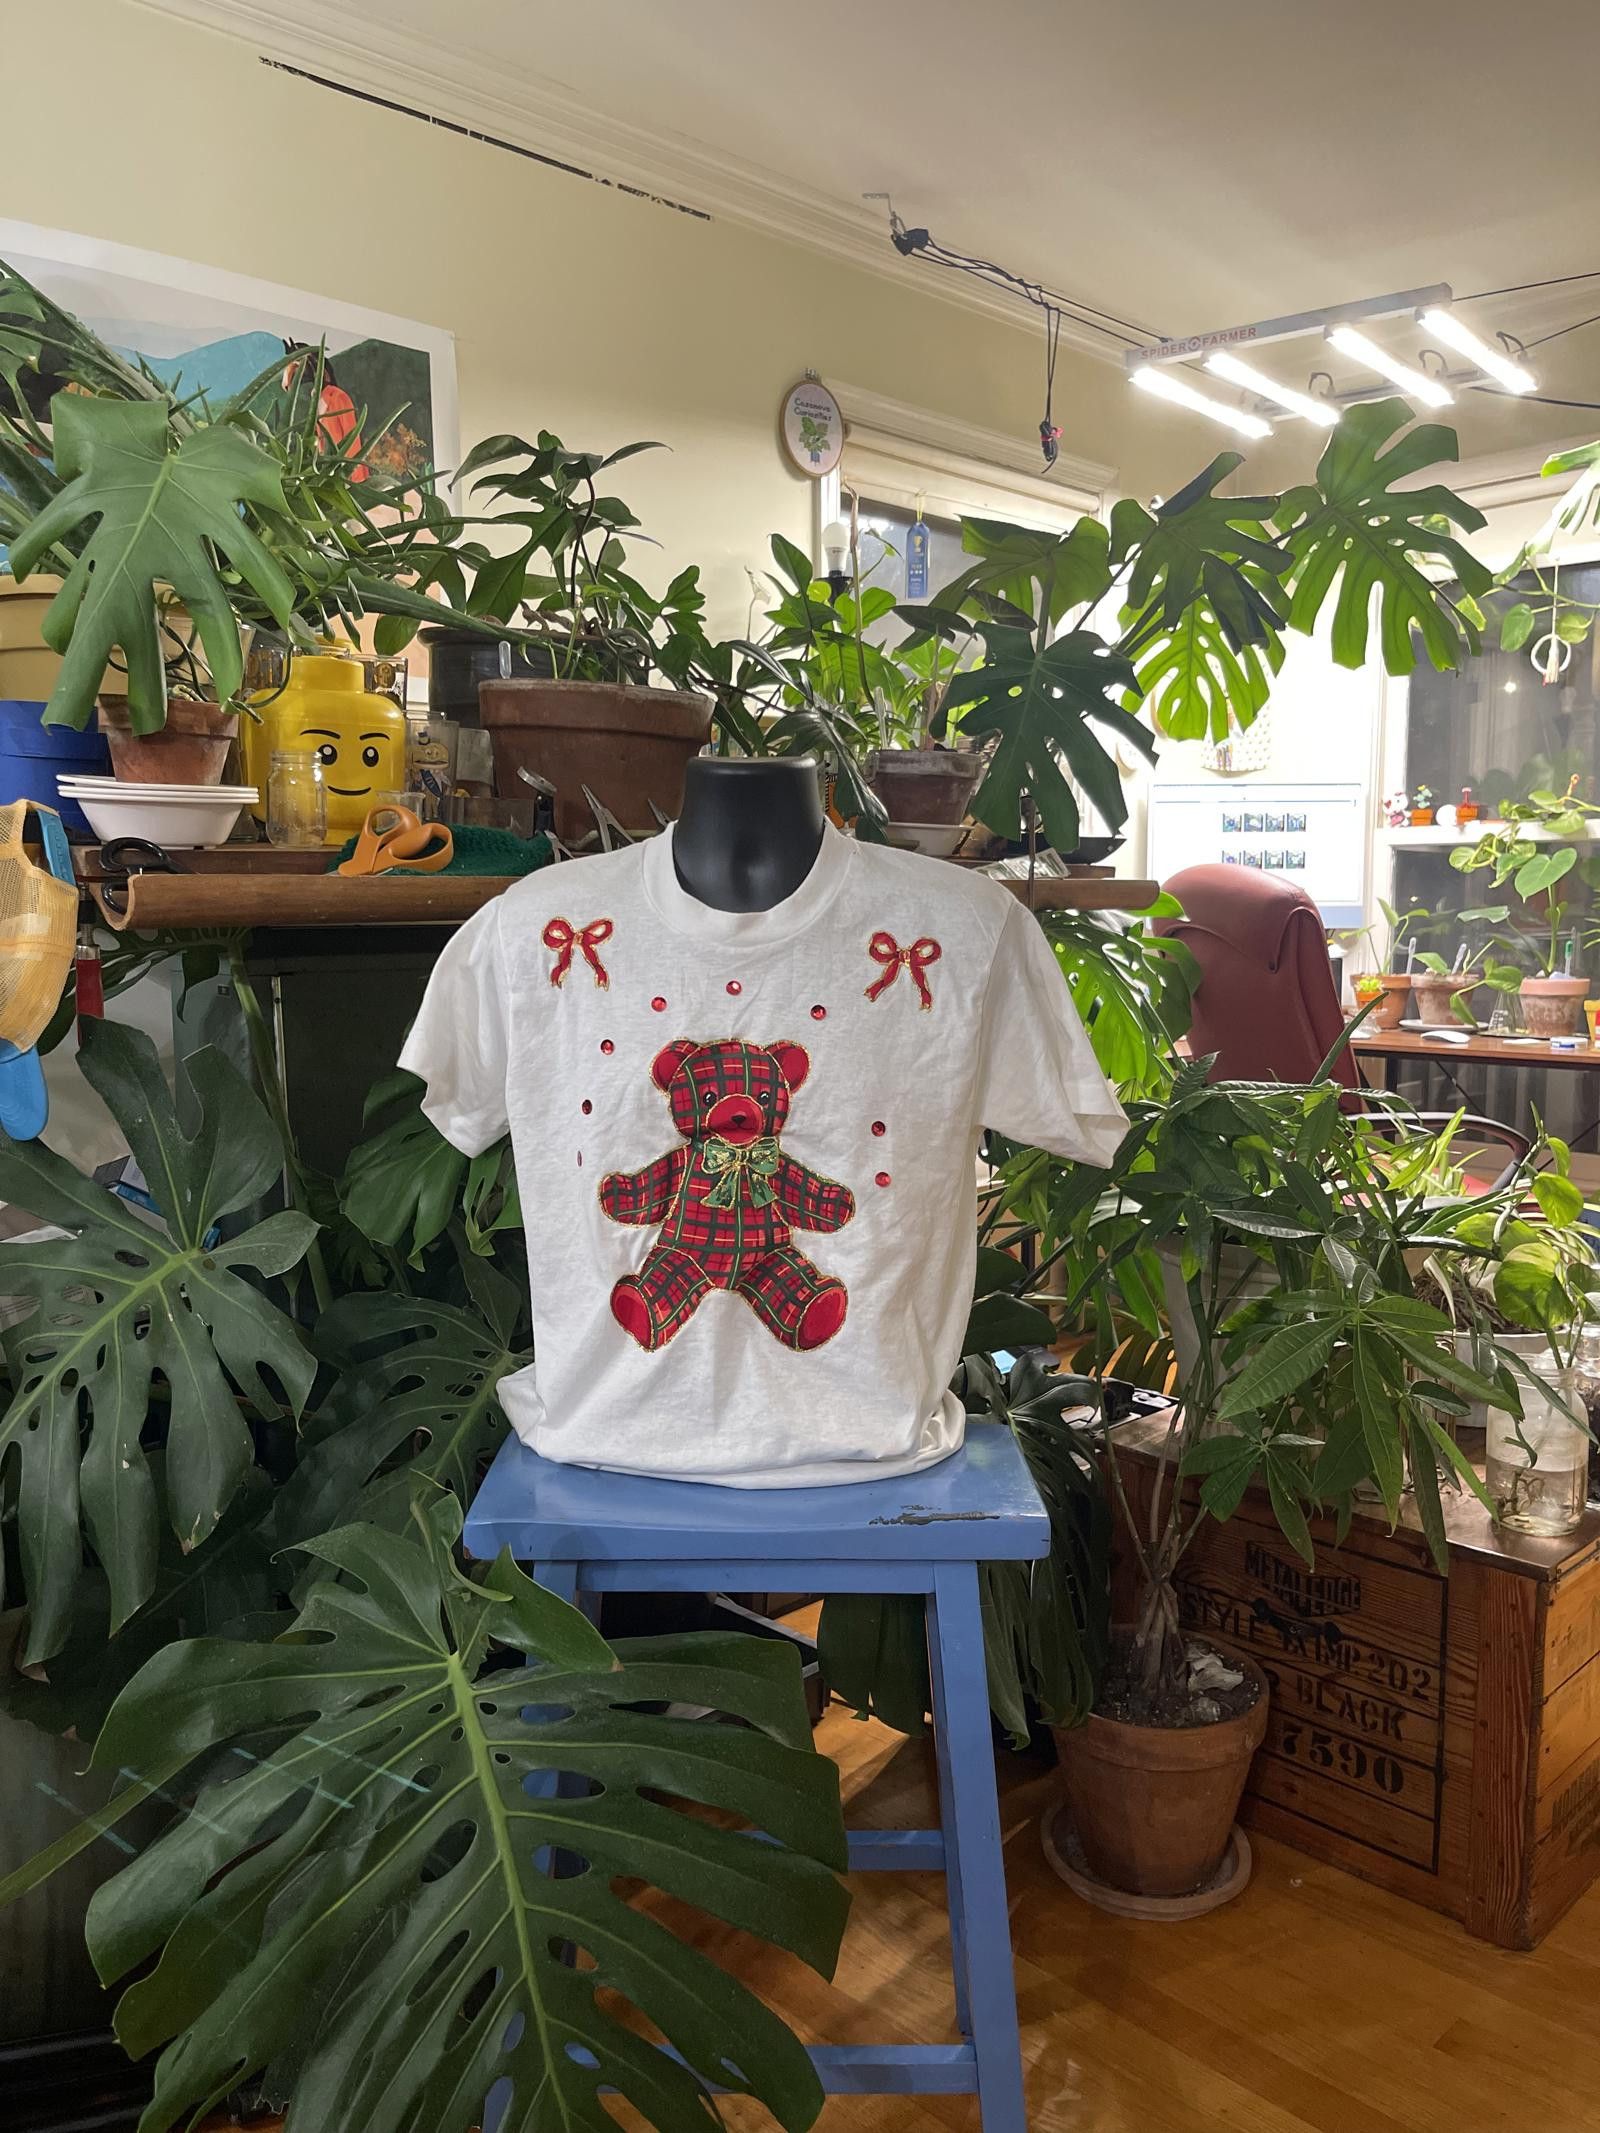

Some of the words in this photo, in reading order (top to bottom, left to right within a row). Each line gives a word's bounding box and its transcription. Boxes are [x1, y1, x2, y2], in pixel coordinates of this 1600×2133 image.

[1140, 342, 1187, 361] SPIDER
[1202, 327, 1257, 347] FARMER
[1296, 1673, 1408, 1742] BLACK
[1280, 1720, 1405, 1795] 7590
